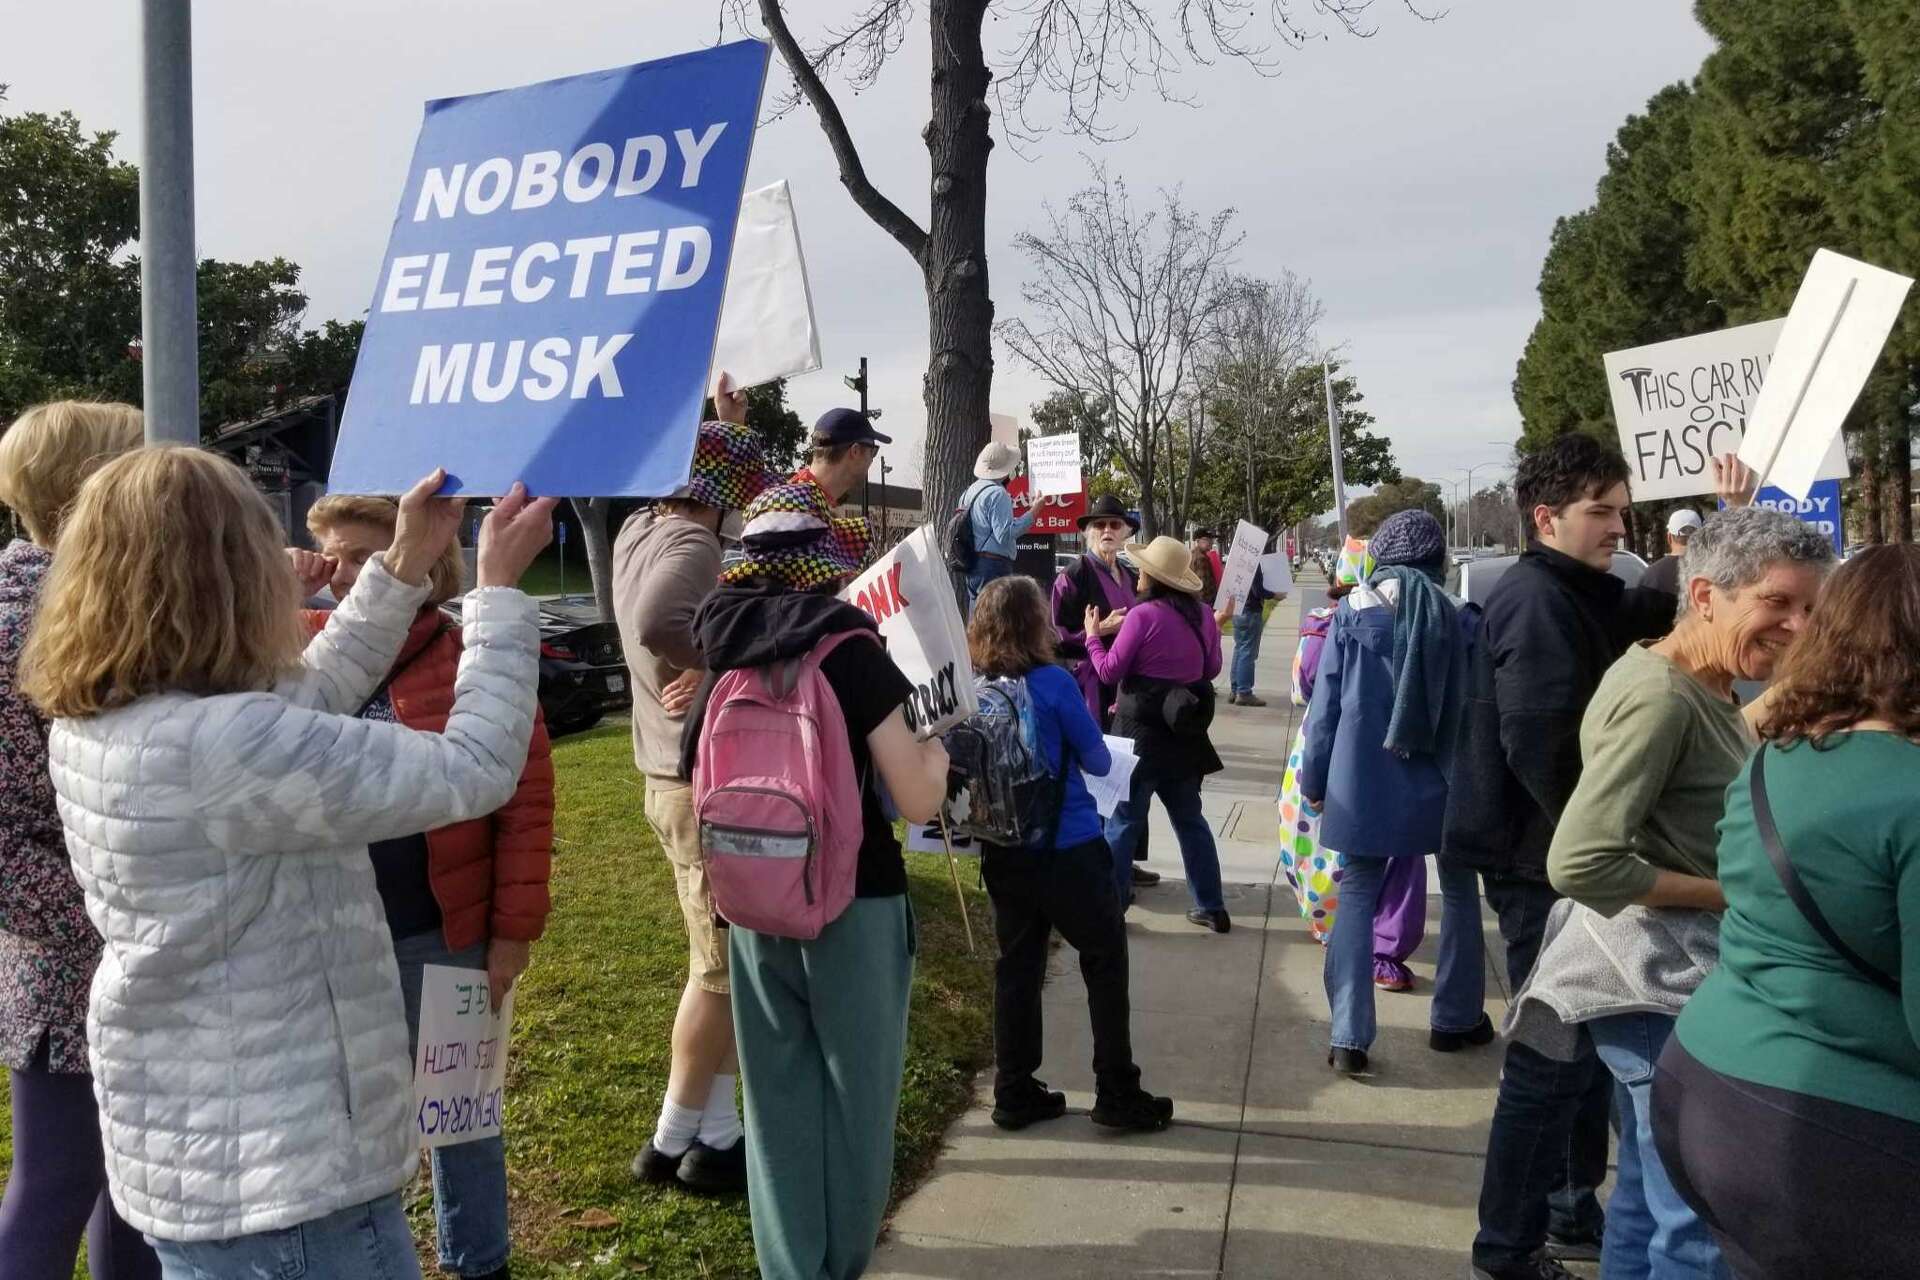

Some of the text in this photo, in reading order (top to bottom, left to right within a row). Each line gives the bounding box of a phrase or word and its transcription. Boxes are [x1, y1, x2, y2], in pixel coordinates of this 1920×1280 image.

[414, 122, 728, 222] NOBODY
[380, 225, 712, 313] ELECTED
[409, 333, 634, 405] MUSK
[1619, 368, 1685, 415] THIS
[1691, 362, 1741, 403] CAR
[1690, 400, 1746, 422] ON
[1635, 418, 1746, 481] FASC
[1034, 541, 1048, 550] Real
[1049, 516, 1071, 527] Bar
[848, 561, 910, 624] ONK
[903, 661, 958, 734] OCRACY
[424, 1042, 467, 1075] WITH
